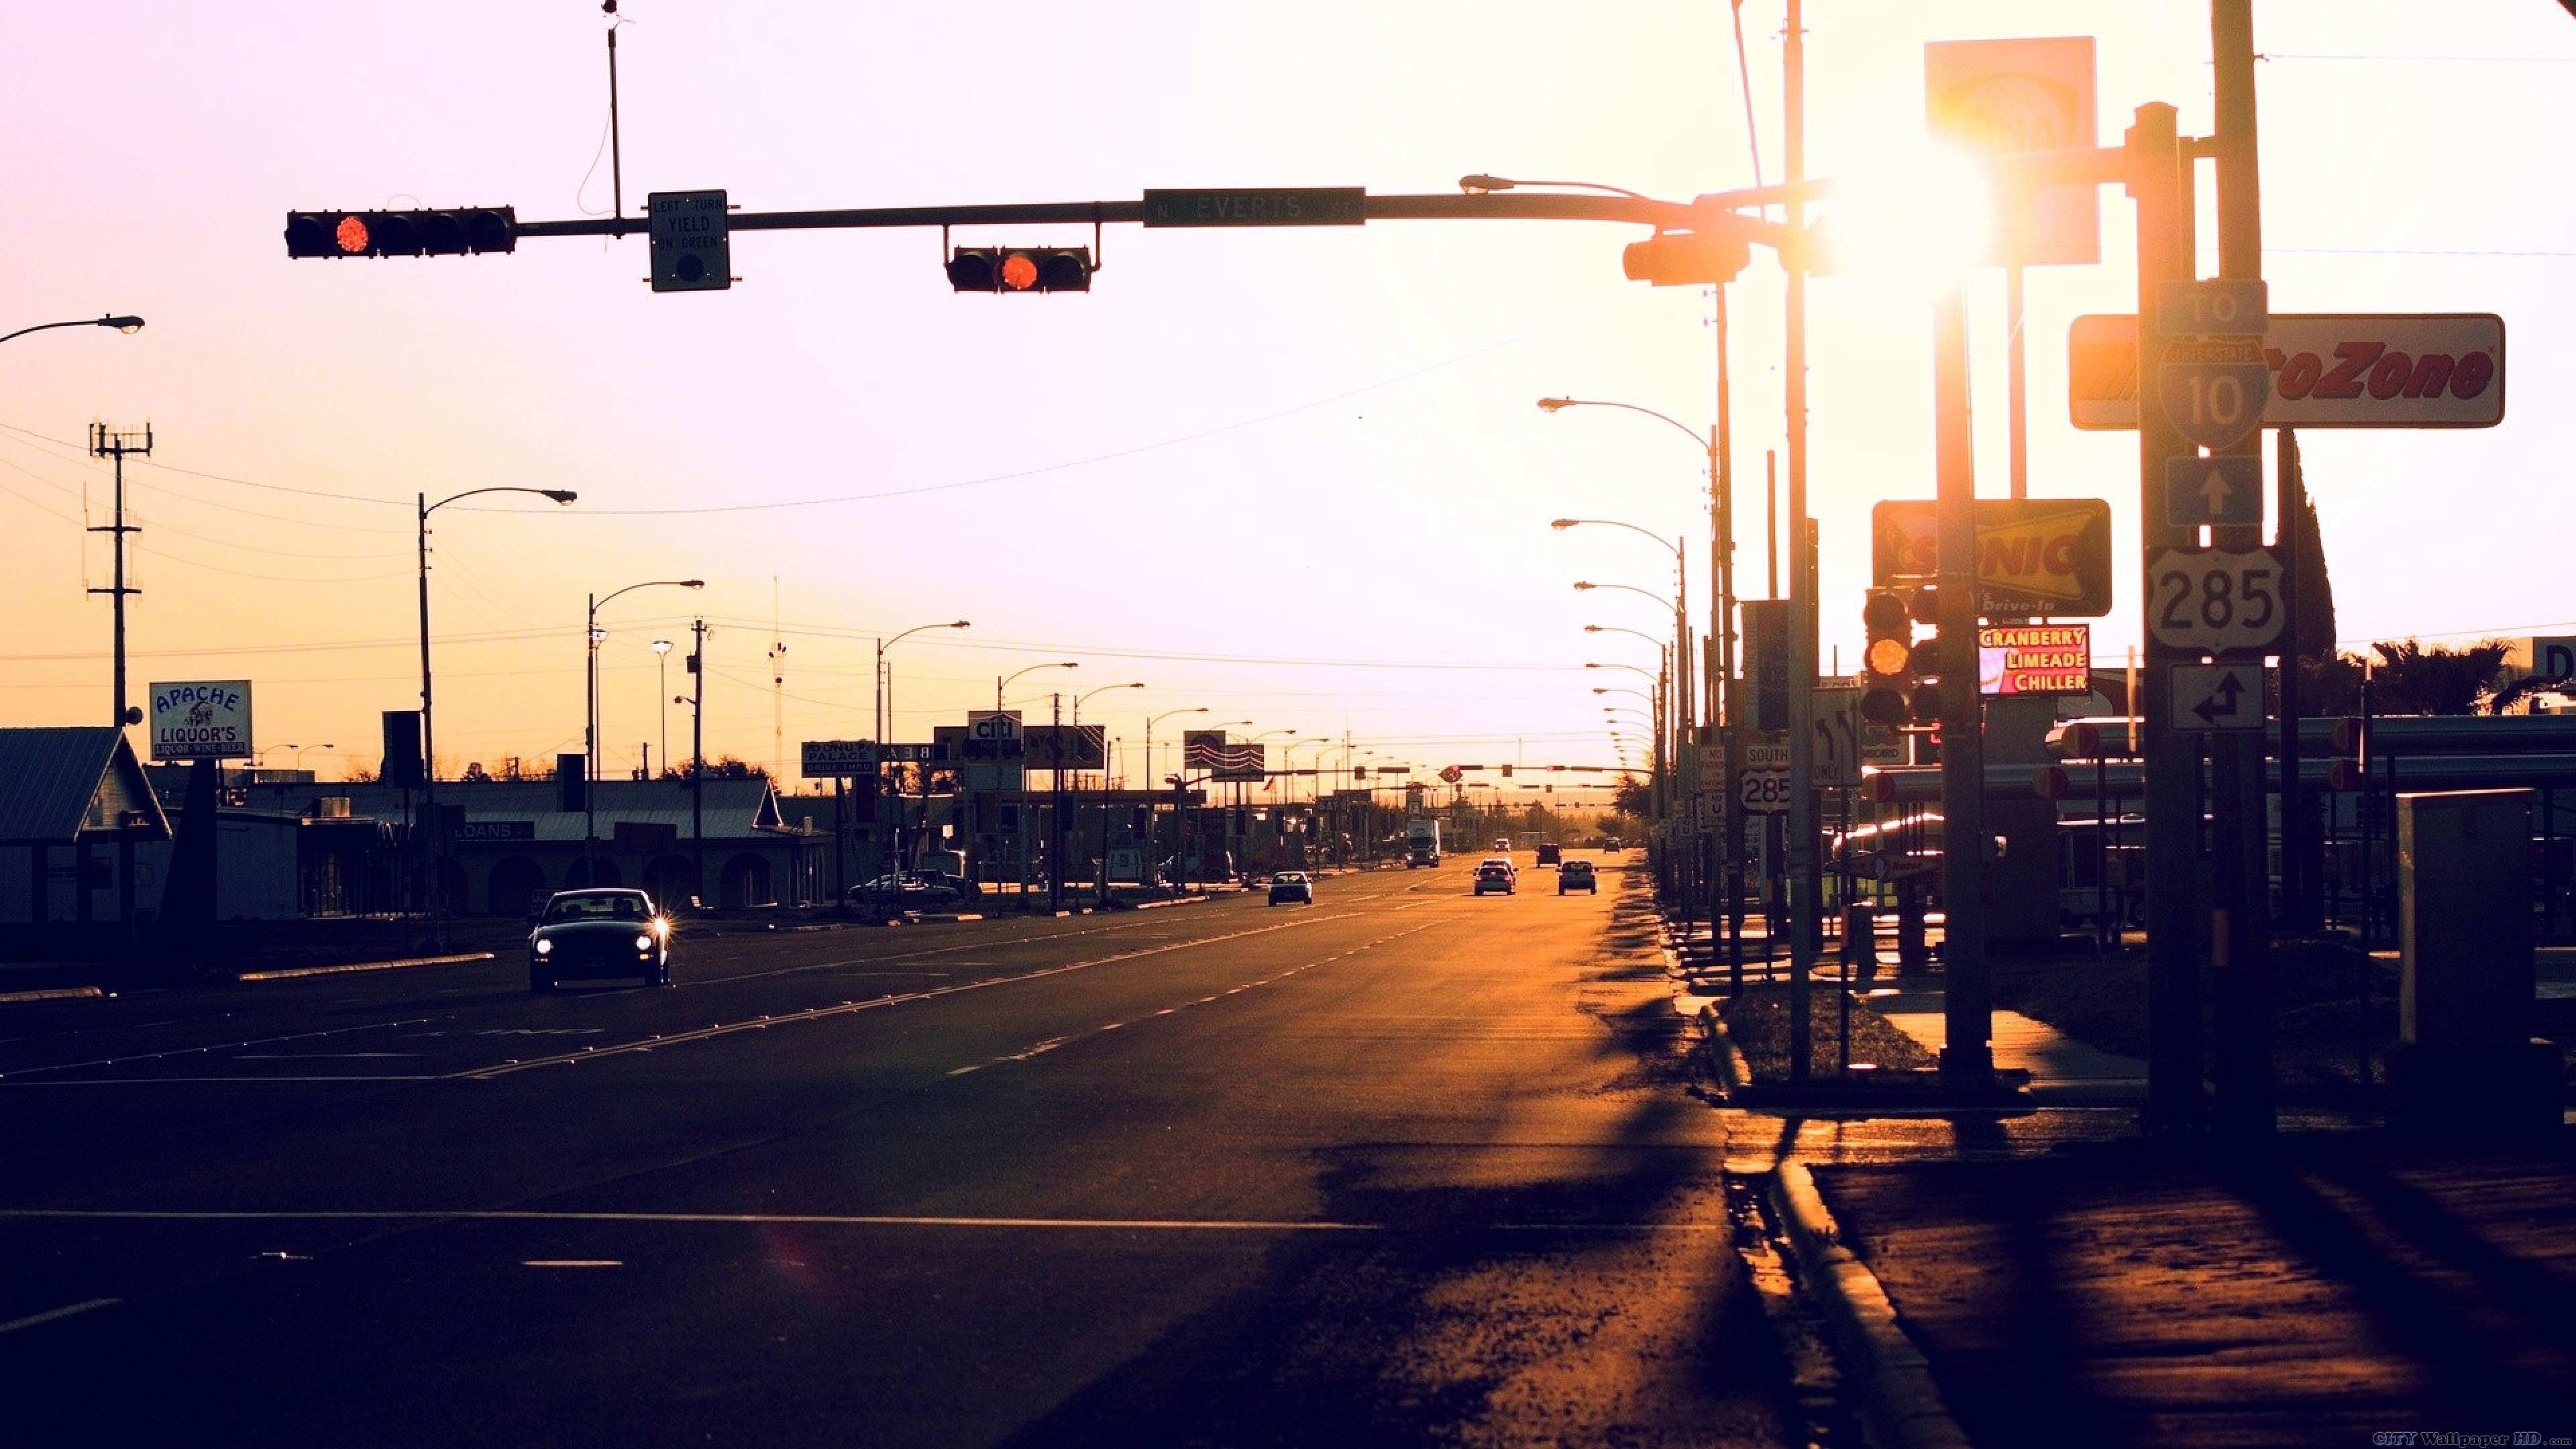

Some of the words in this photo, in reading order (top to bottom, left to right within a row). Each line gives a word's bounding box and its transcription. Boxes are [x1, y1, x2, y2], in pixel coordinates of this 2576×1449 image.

[654, 201, 678, 213] LEFT
[696, 198, 722, 211] TURN
[1197, 196, 1302, 218] EVERTS
[669, 216, 709, 231] YIELD
[658, 237, 673, 248] ON
[682, 235, 717, 248] GREEN
[2189, 292, 2237, 321] TO
[2190, 374, 2243, 423] 10
[2159, 570, 2273, 629] 285
[1980, 629, 2084, 646] CRANBERRY
[2006, 652, 2086, 668] LIMEADE
[2016, 674, 2086, 690] CHILLER
[156, 686, 239, 714] APACHE
[160, 727, 236, 743] LIQUOR'S
[1748, 749, 1788, 761] SOUTH
[1745, 778, 1790, 803] 285
